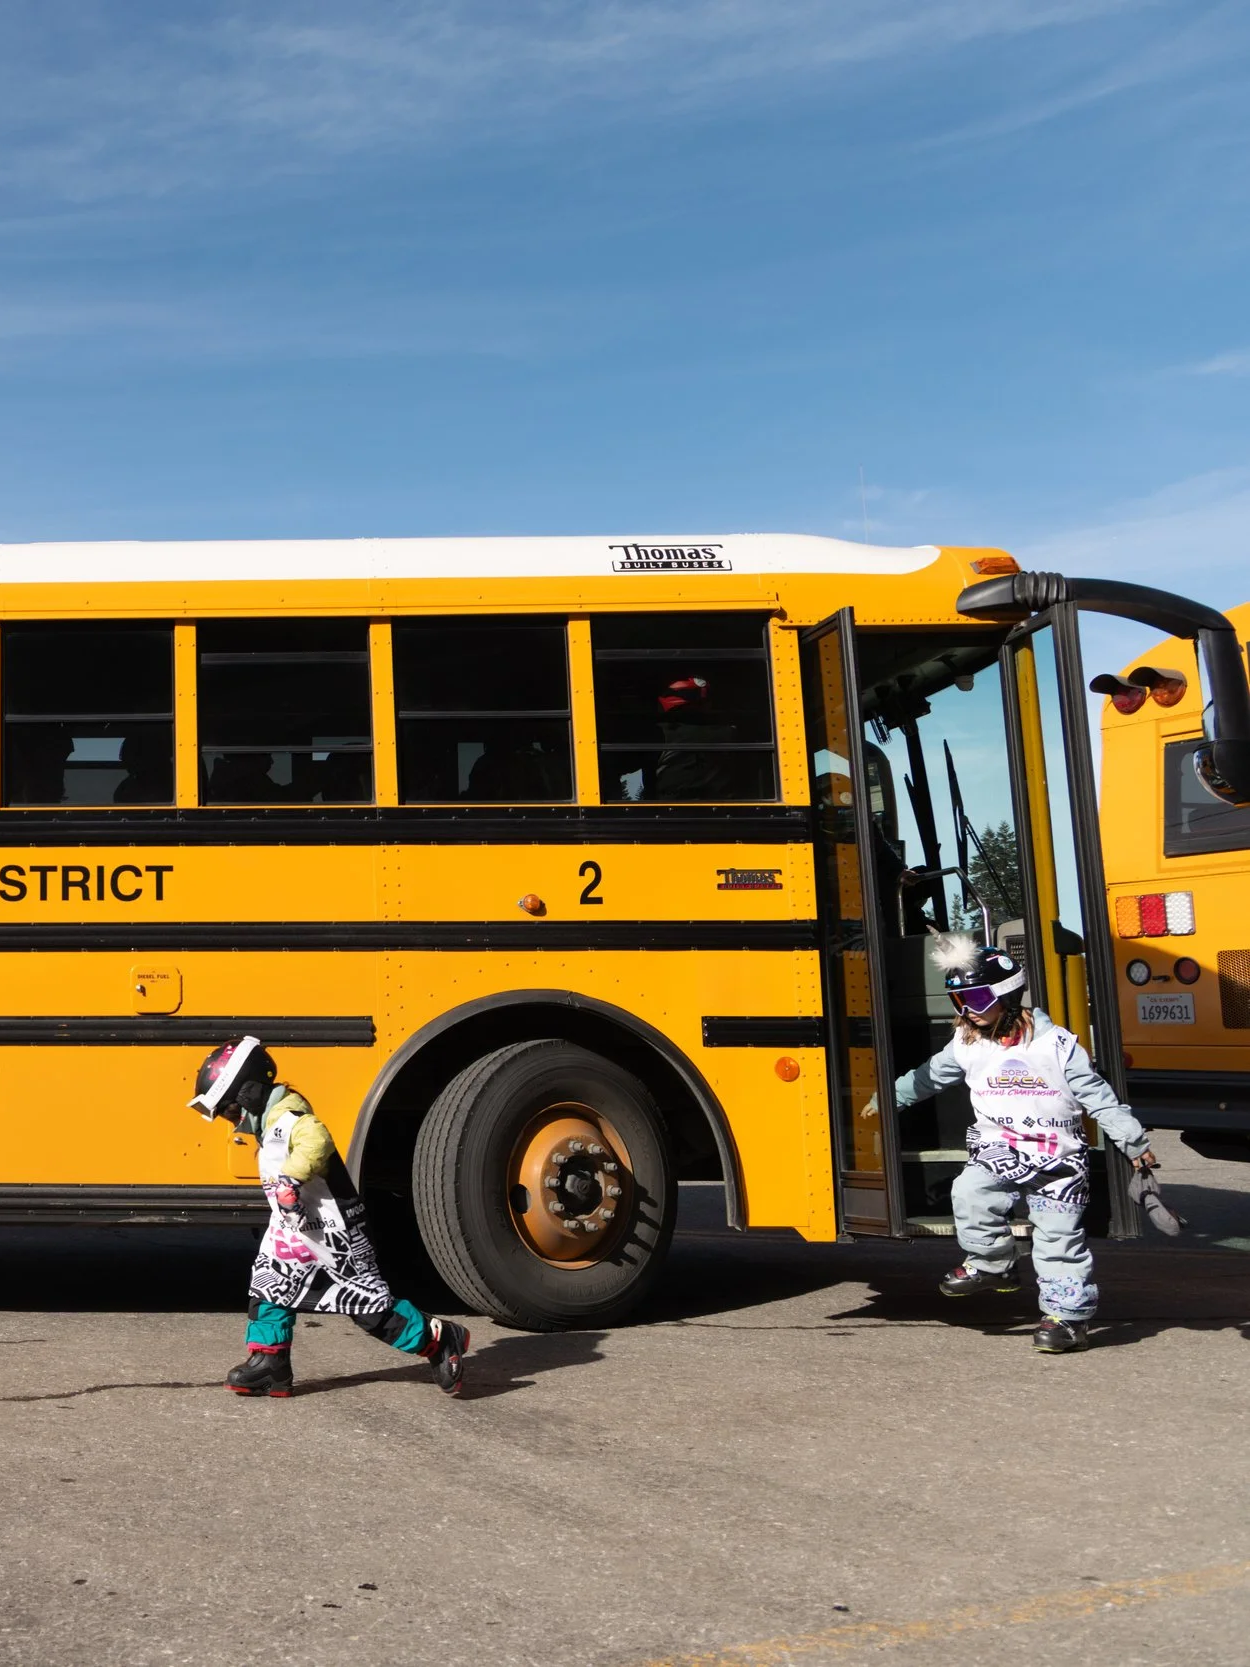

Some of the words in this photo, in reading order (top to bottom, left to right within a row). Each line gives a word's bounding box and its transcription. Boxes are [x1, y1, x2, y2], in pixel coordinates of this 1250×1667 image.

[609, 543, 723, 560] Thomas
[623, 561, 664, 569] BUILT
[670, 560, 720, 568] BUSES
[579, 861, 602, 904] 2
[1141, 1005, 1191, 1020] 1699631
[987, 1076, 1049, 1089] USASA
